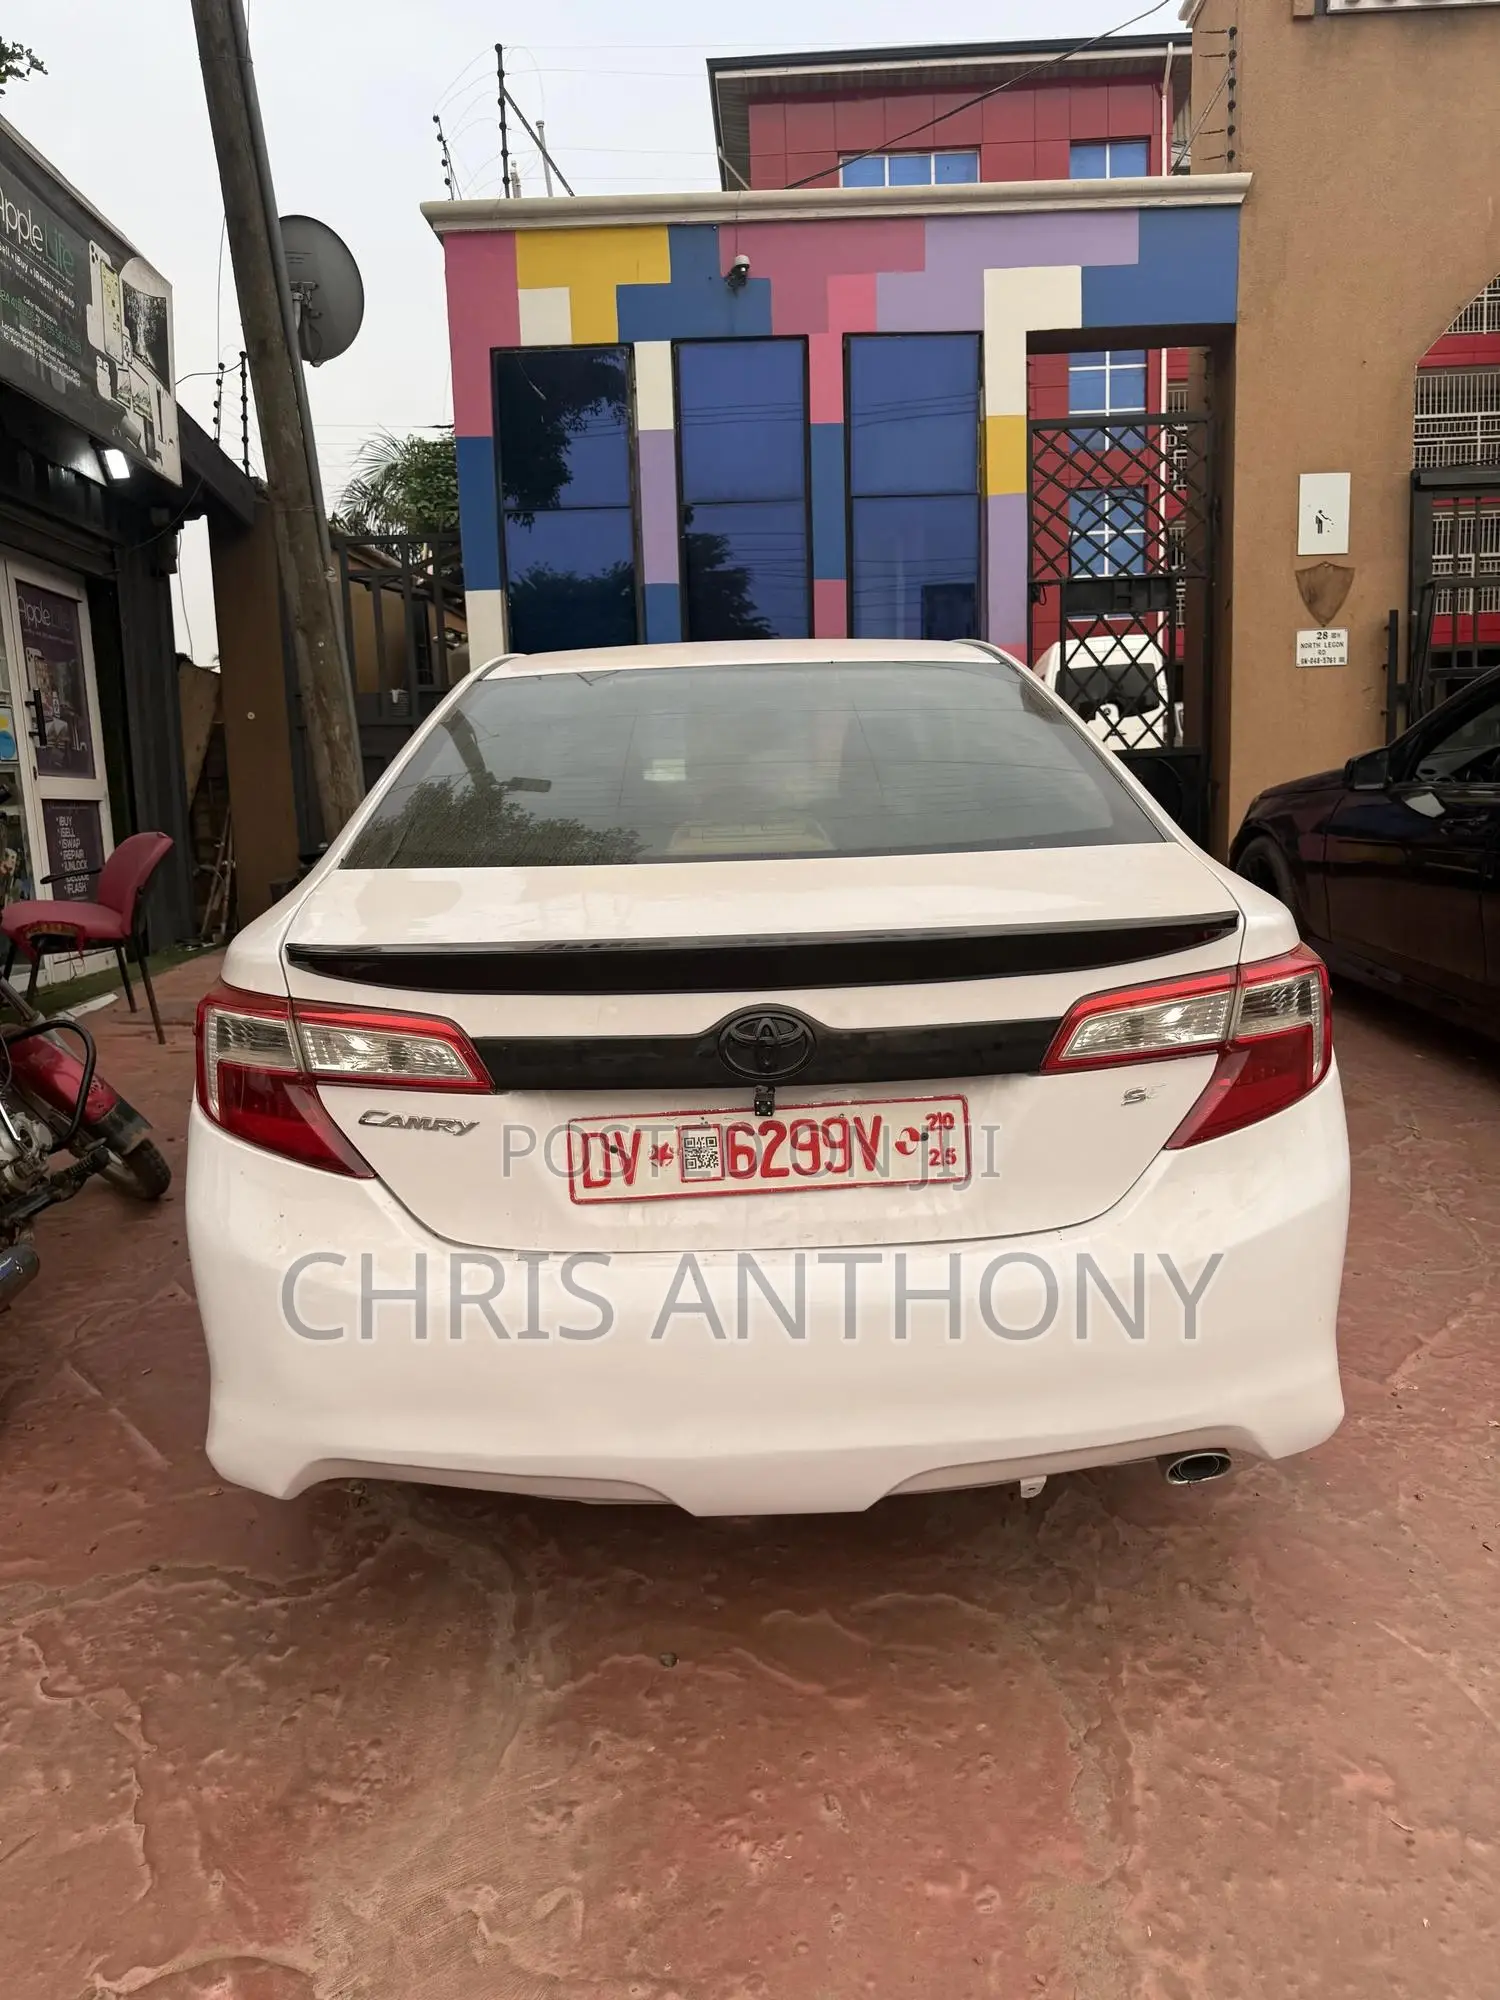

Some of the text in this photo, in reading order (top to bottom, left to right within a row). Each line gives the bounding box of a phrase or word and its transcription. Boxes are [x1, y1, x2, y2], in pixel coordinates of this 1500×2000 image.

[1316, 631, 1329, 640] 28
[1323, 641, 1345, 649] LEGON
[358, 1109, 480, 1136] CAMRY
[582, 1116, 882, 1188] DV 6299V
